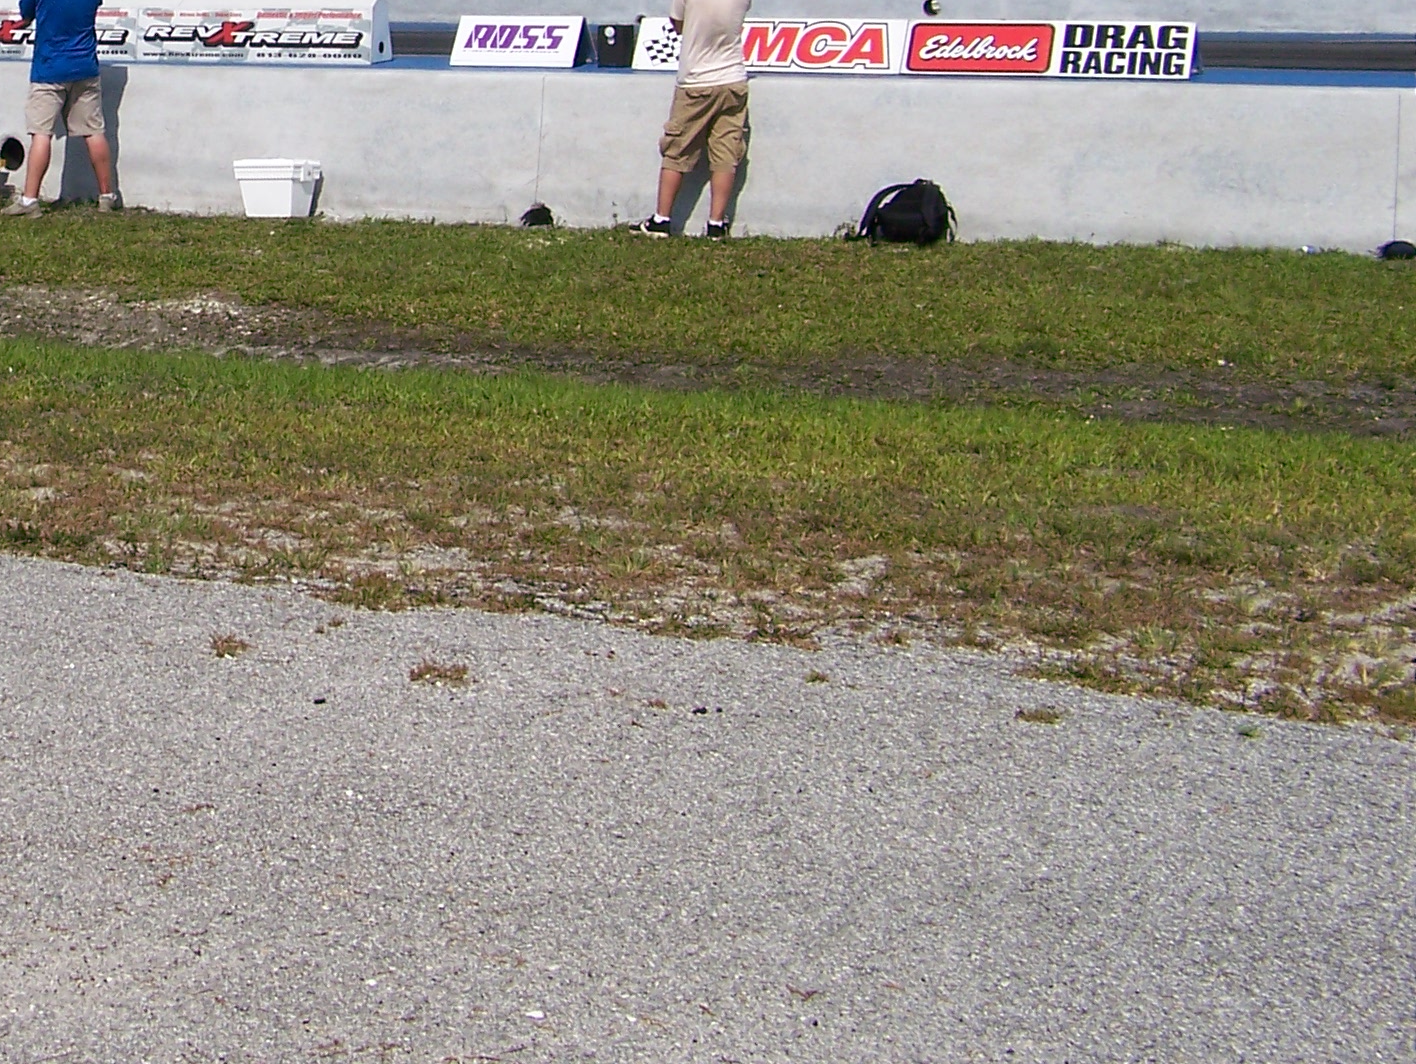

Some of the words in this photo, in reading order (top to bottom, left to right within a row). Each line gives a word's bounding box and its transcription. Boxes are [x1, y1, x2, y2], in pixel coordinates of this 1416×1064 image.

[463, 25, 570, 49] ROSS
[918, 33, 1037, 62] Edelbrock
[1062, 24, 1189, 50] DRAG
[1060, 50, 1185, 76] RACING
